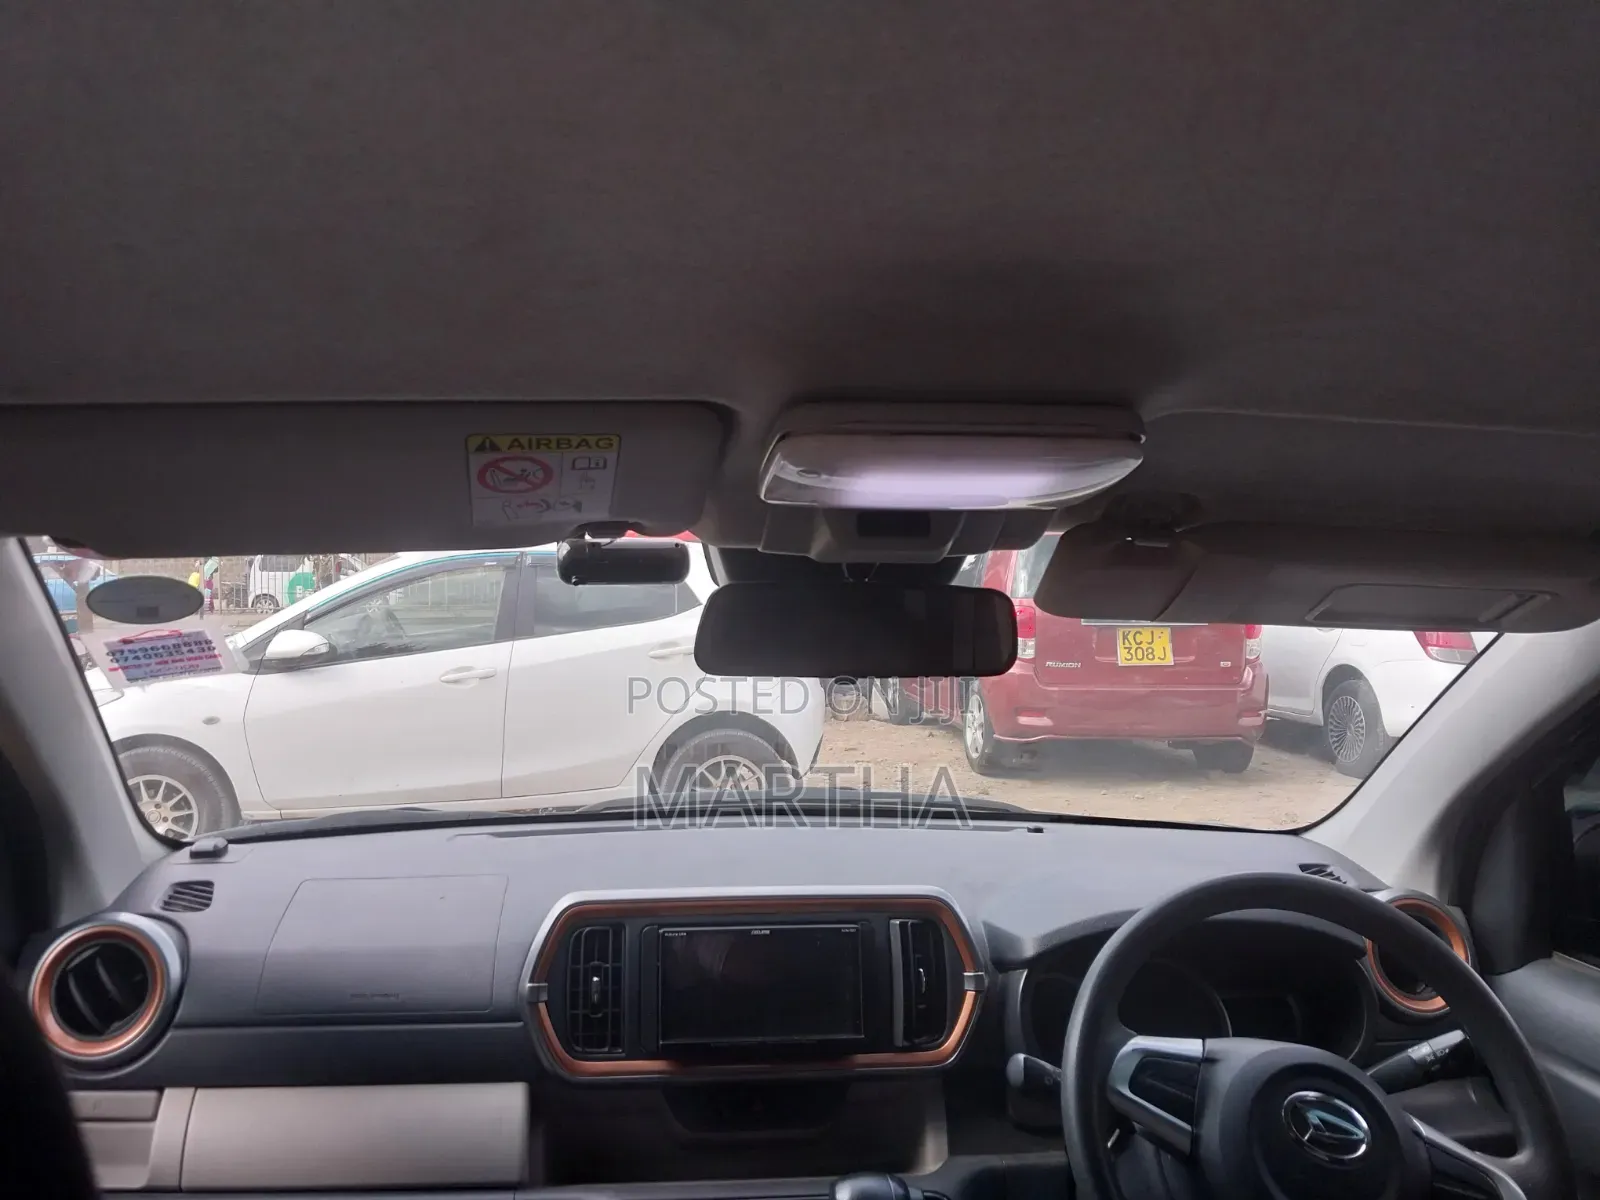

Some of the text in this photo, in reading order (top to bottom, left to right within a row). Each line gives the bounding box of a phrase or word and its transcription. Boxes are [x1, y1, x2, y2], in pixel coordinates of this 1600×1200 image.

[507, 437, 615, 450] AIRBAG
[1122, 630, 1155, 646] KCJ
[1123, 646, 1167, 662] 308J
